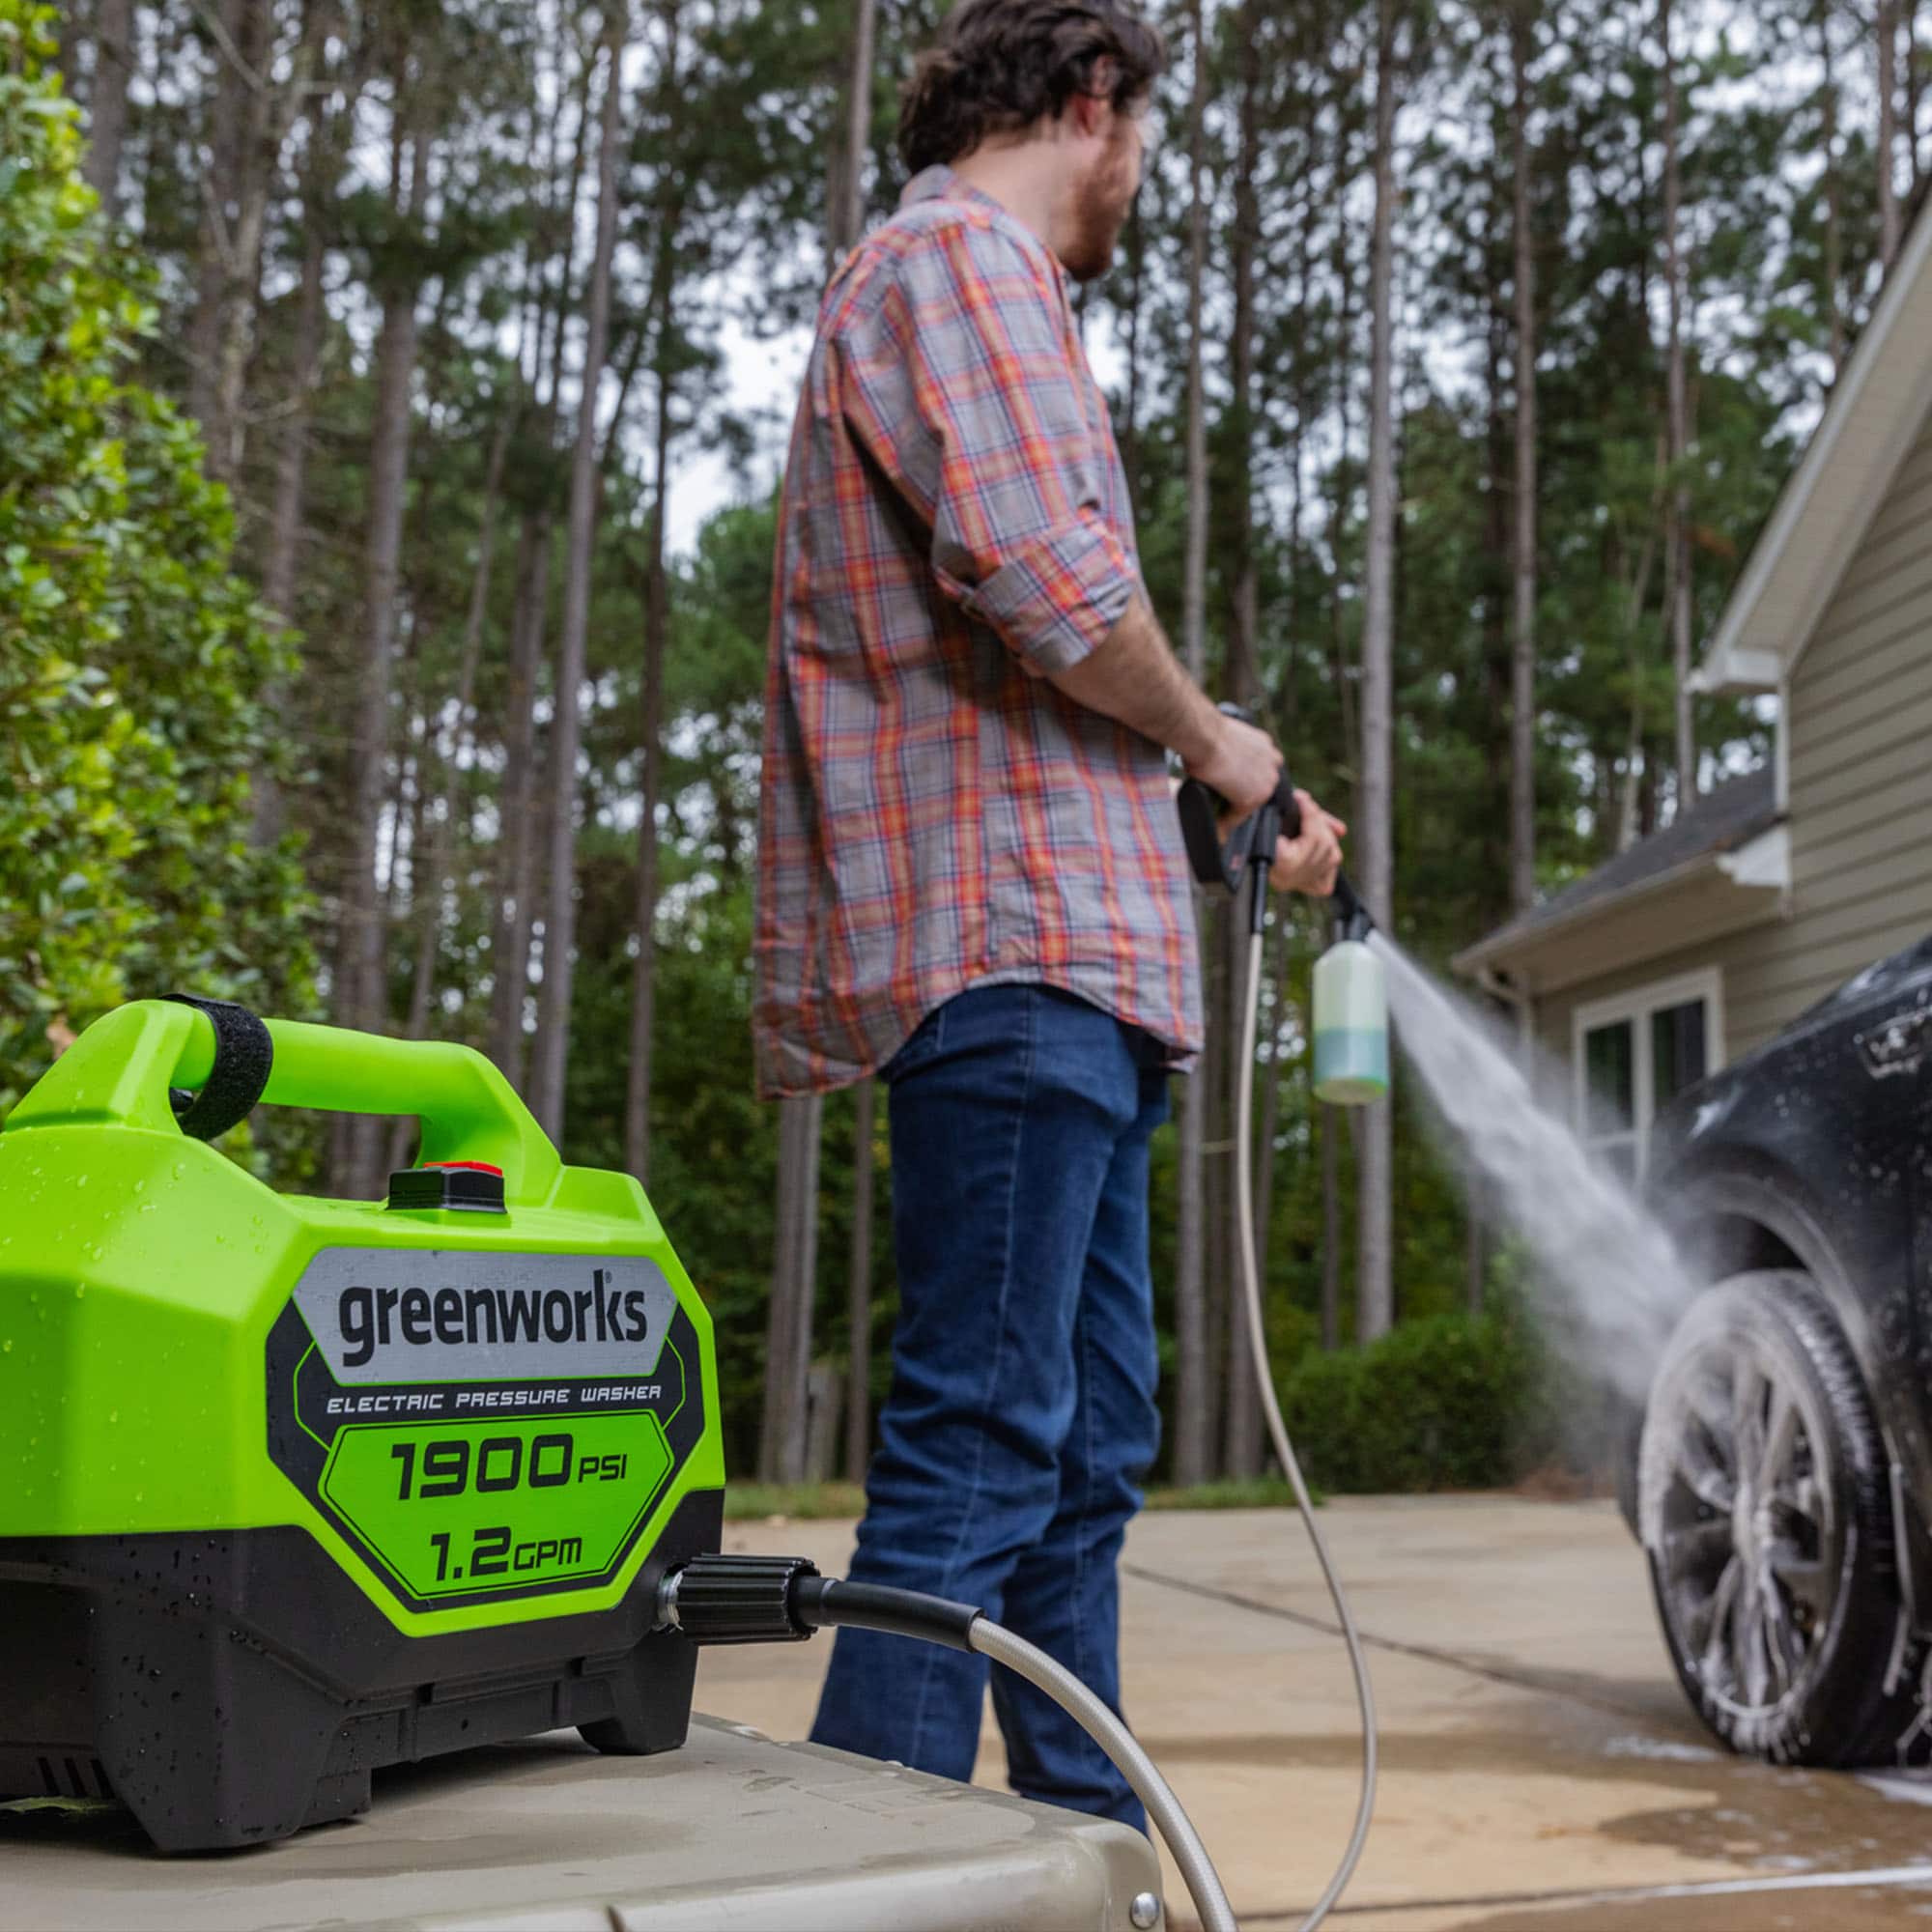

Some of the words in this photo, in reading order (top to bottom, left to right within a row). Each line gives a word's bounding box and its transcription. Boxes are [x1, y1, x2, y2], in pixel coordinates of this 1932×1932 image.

[338, 1268, 648, 1367] greenworks
[327, 1393, 444, 1413] ELECTRIC
[456, 1388, 570, 1407] PRESSURE
[581, 1384, 662, 1403] WASHER
[390, 1434, 573, 1500] 1900
[579, 1454, 627, 1483] PSI
[430, 1526, 511, 1581] 1.2
[514, 1537, 582, 1570] GPM
